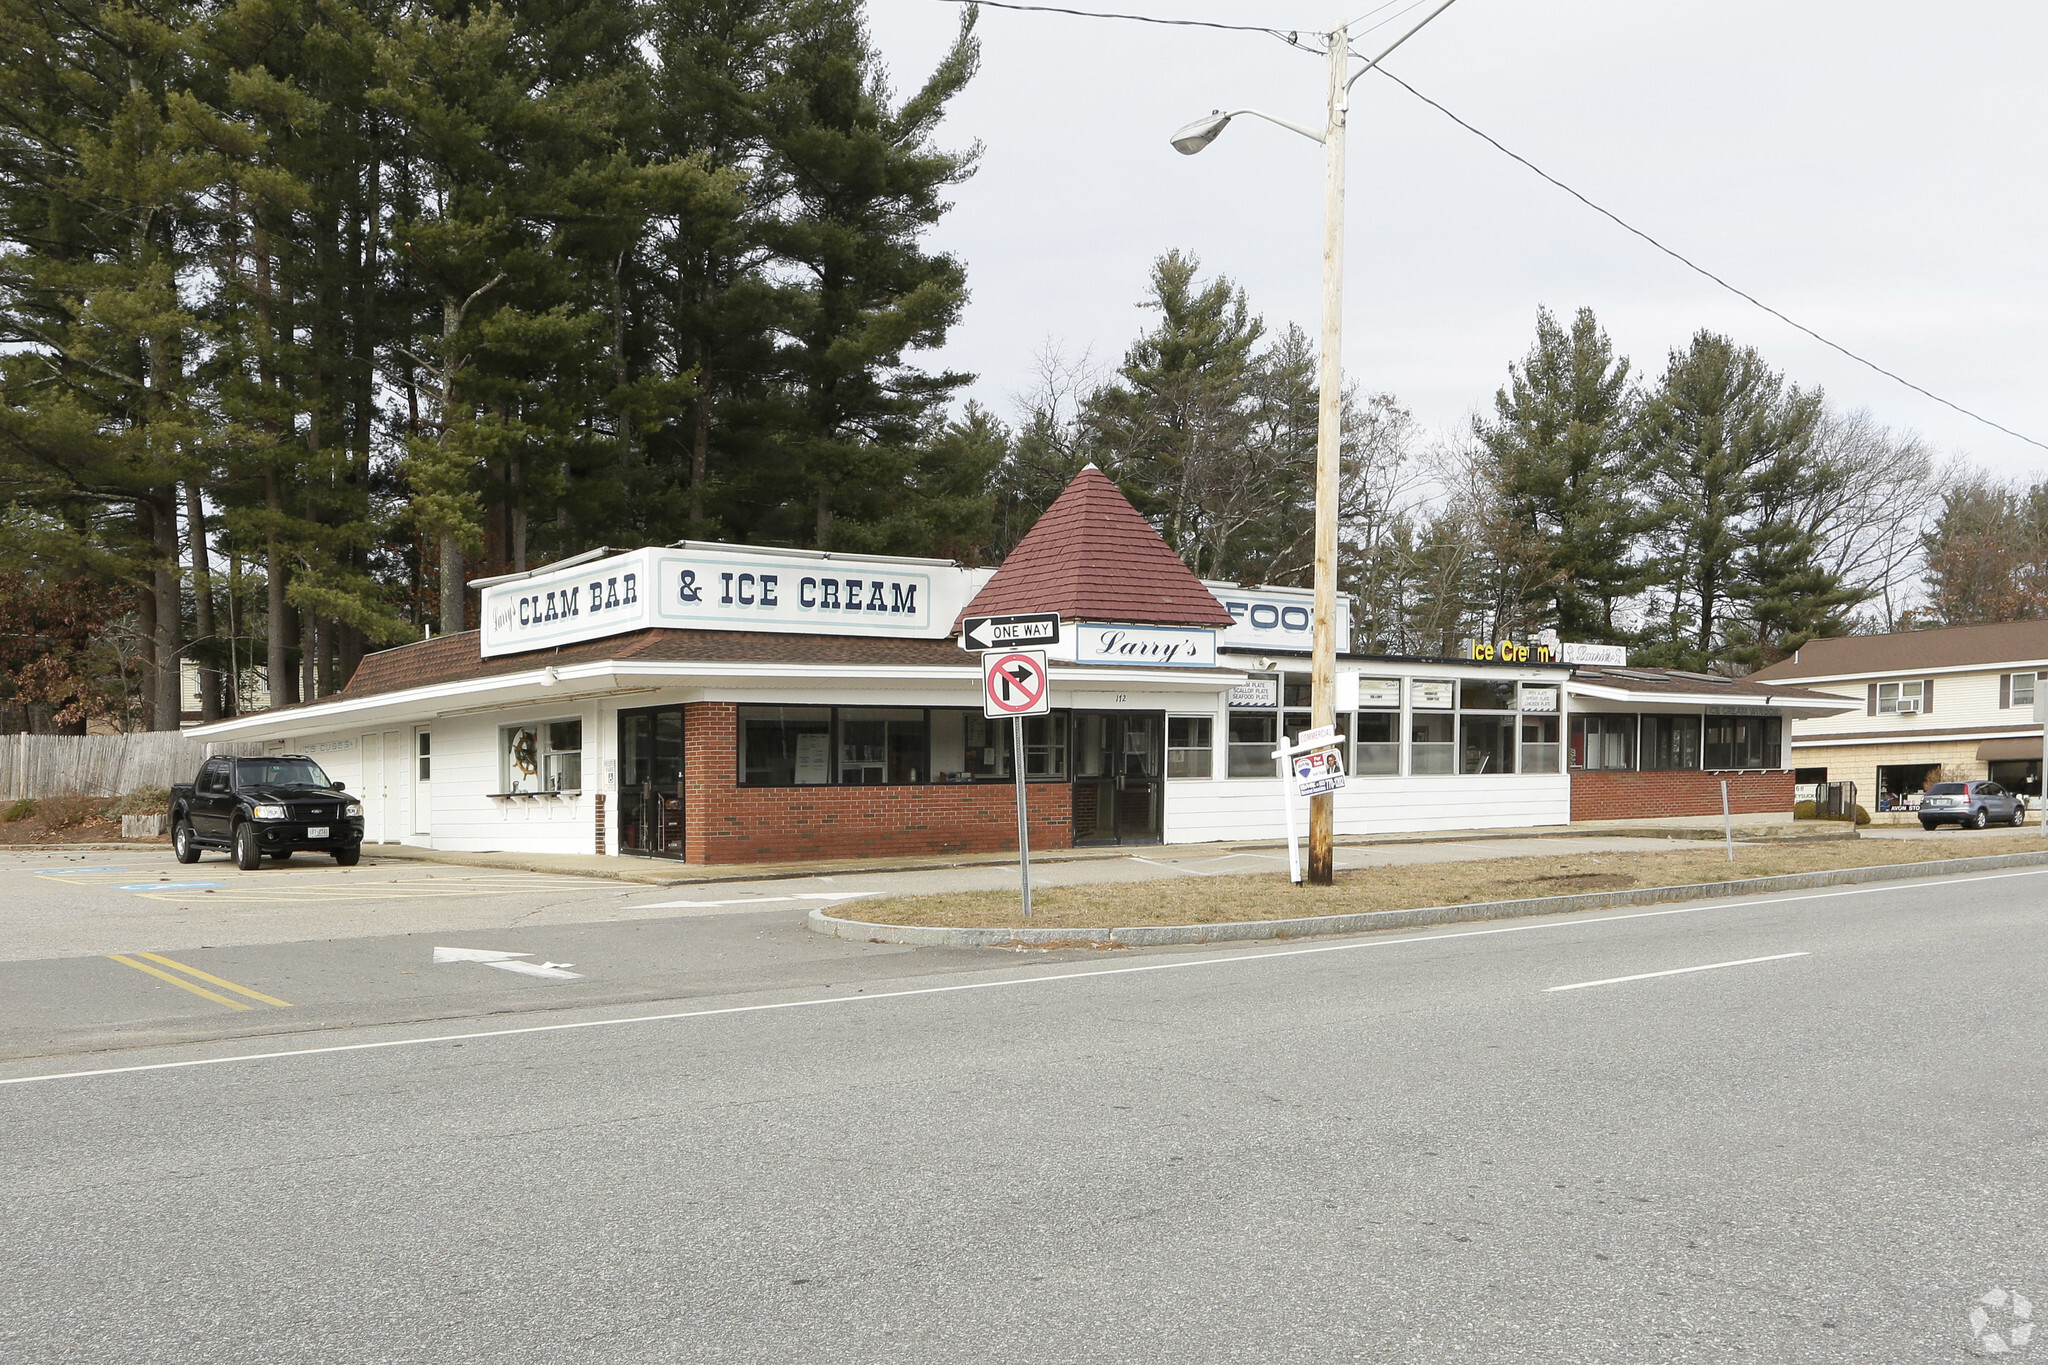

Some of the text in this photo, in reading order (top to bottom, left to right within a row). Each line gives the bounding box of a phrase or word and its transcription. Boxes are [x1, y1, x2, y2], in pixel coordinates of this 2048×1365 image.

[519, 586, 579, 626] CLAM
[590, 572, 638, 613] BAR
[679, 569, 917, 614] & ICE CREAM
[993, 623, 1049, 639] ONE WAY
[1226, 601, 1314, 631] FOO
[1095, 630, 1197, 663] Larry's
[1471, 638, 1494, 661] Ice
[1501, 639, 1549, 662] Crem
[1300, 728, 1332, 744] COMMERCIAL
